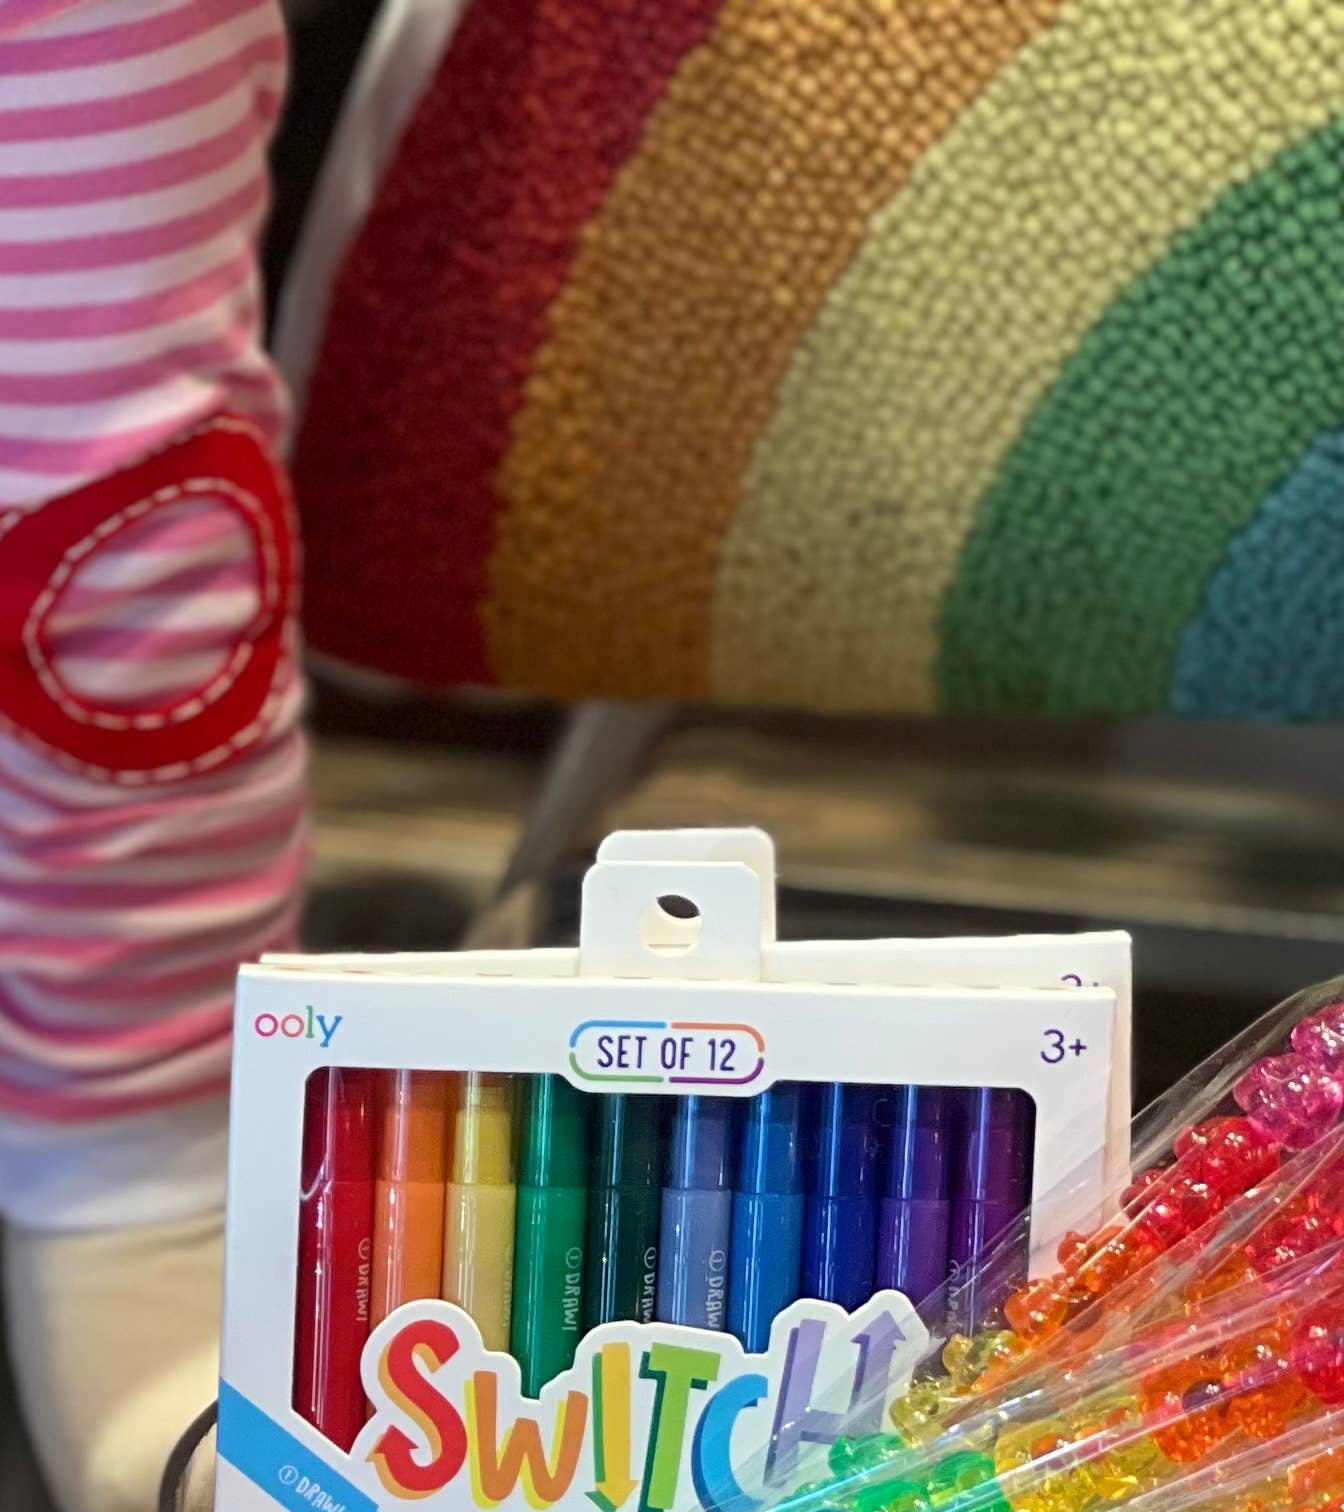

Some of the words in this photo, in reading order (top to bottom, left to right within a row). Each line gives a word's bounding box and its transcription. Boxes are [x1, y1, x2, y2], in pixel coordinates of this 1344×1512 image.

[254, 1005, 343, 1048] ooly
[1040, 1028, 1087, 1064] 3+
[597, 1035, 647, 1069] SET
[661, 1036, 695, 1070] OF
[707, 1038, 737, 1072] 12
[561, 1273, 581, 1331] DRAW!
